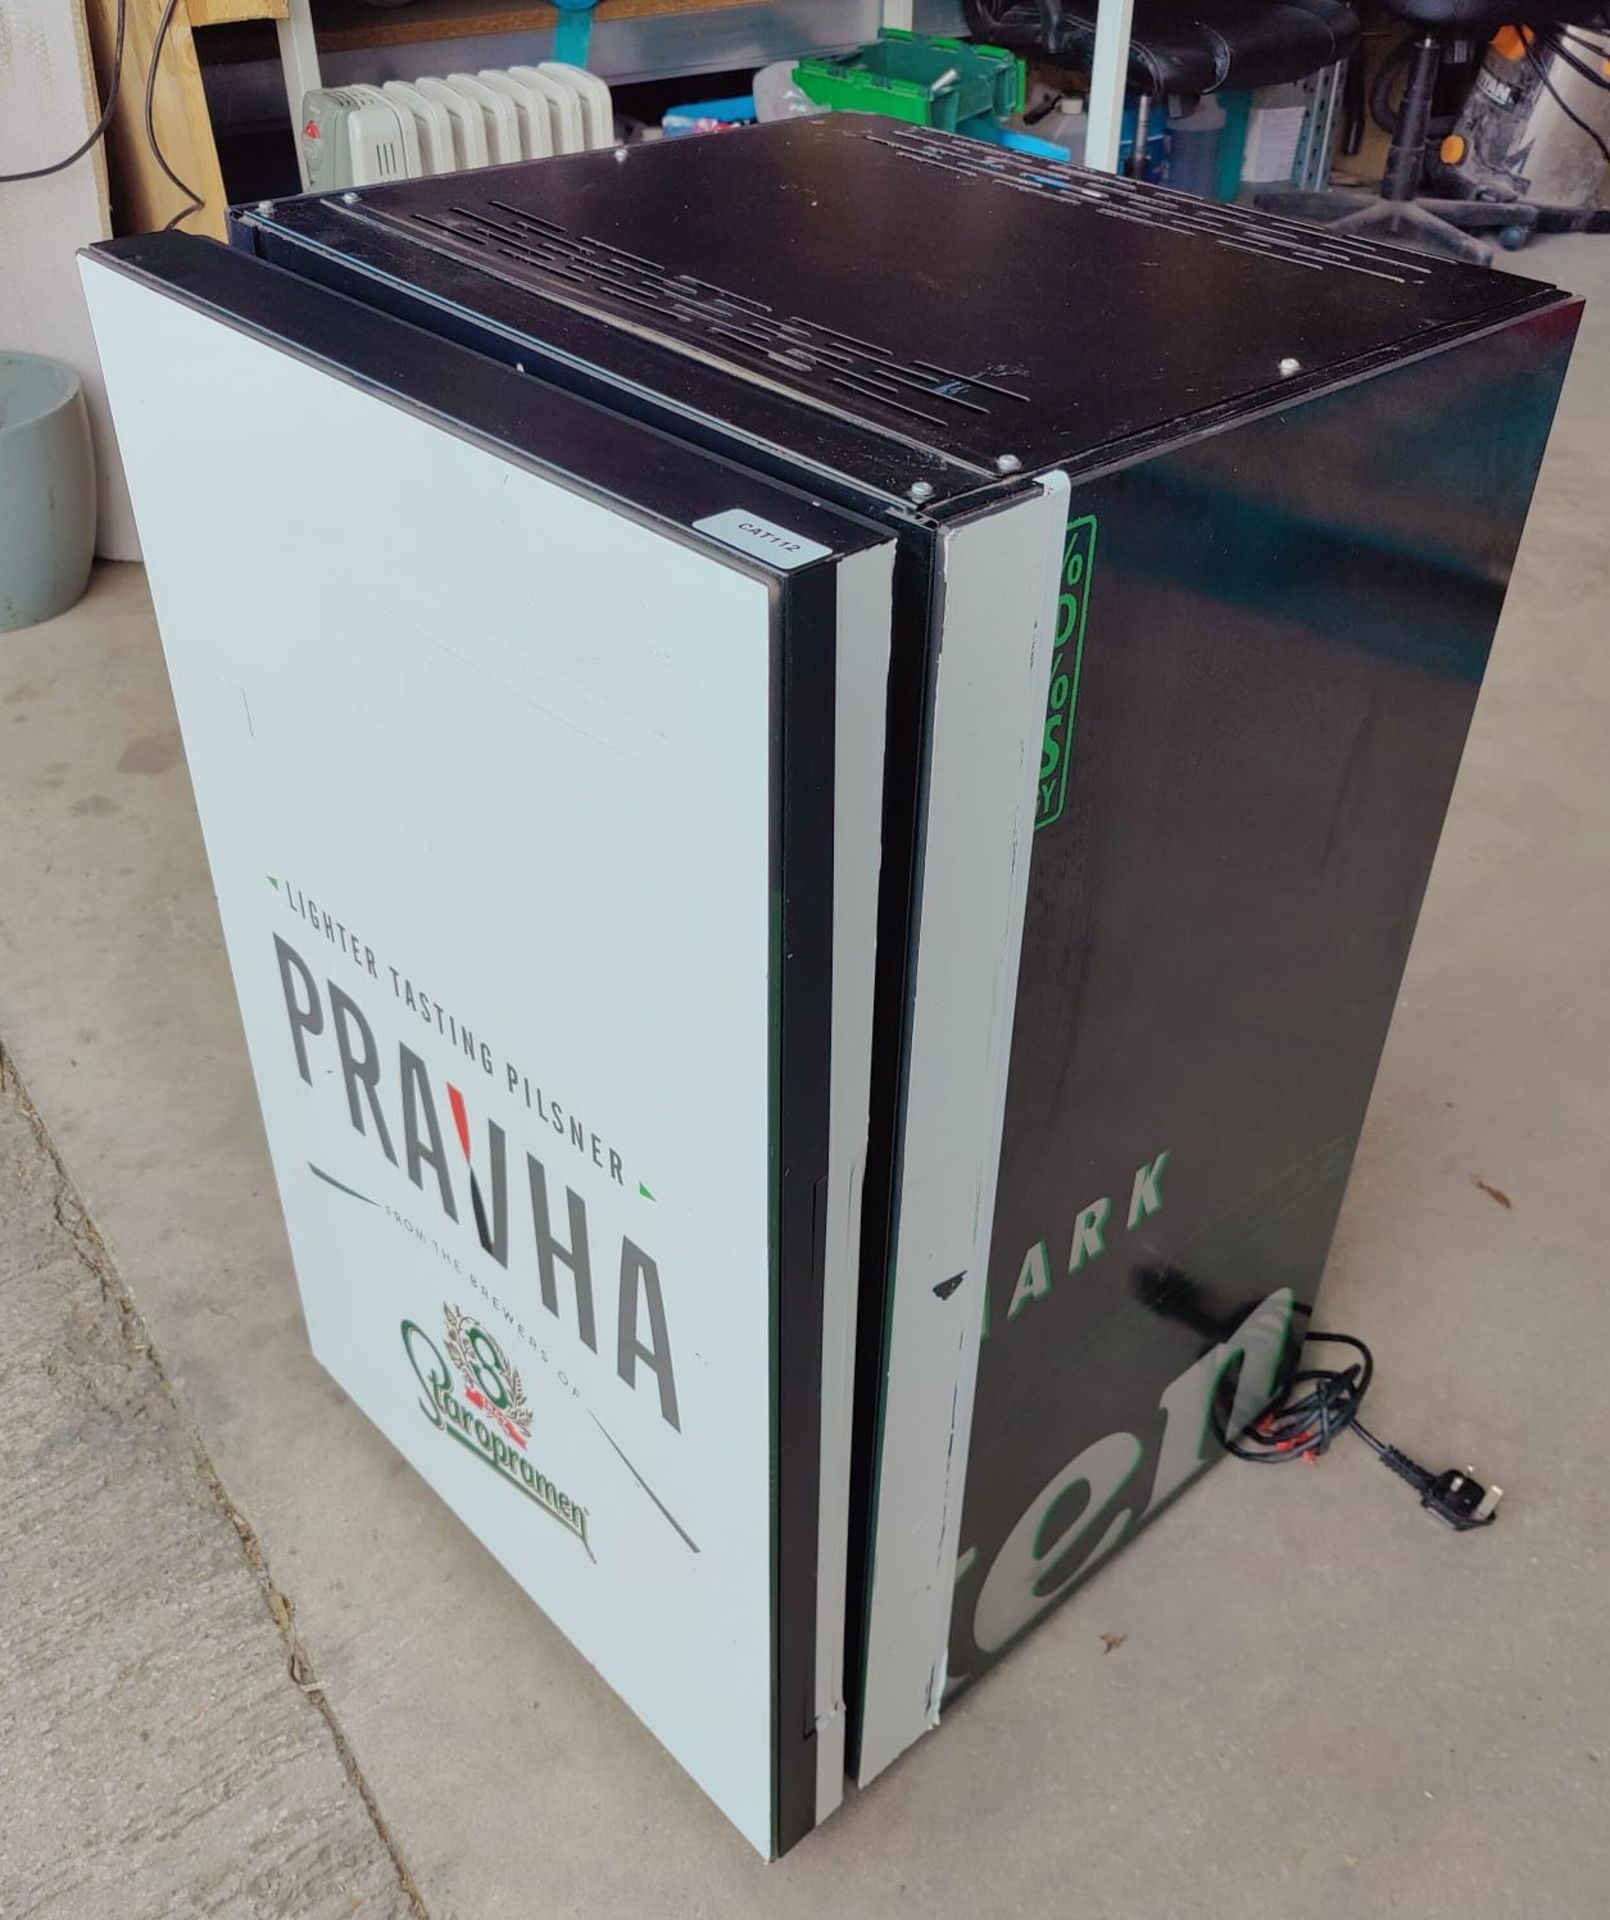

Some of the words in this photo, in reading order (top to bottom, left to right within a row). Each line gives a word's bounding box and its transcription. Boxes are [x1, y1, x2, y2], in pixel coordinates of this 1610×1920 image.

[737, 522, 801, 553] CAT112
[285, 880, 380, 979] LIGHTER
[388, 965, 495, 1075] TASTING
[506, 1062, 626, 1186] PILSNER
[272, 930, 682, 1434] PRAVHA
[981, 1149, 1171, 1340] ARK
[384, 1204, 427, 1244] FROM
[429, 1237, 463, 1274] THE
[469, 1273, 550, 1364] BREWERS
[556, 1369, 583, 1398] OF
[400, 1318, 590, 1545] Staropramen
